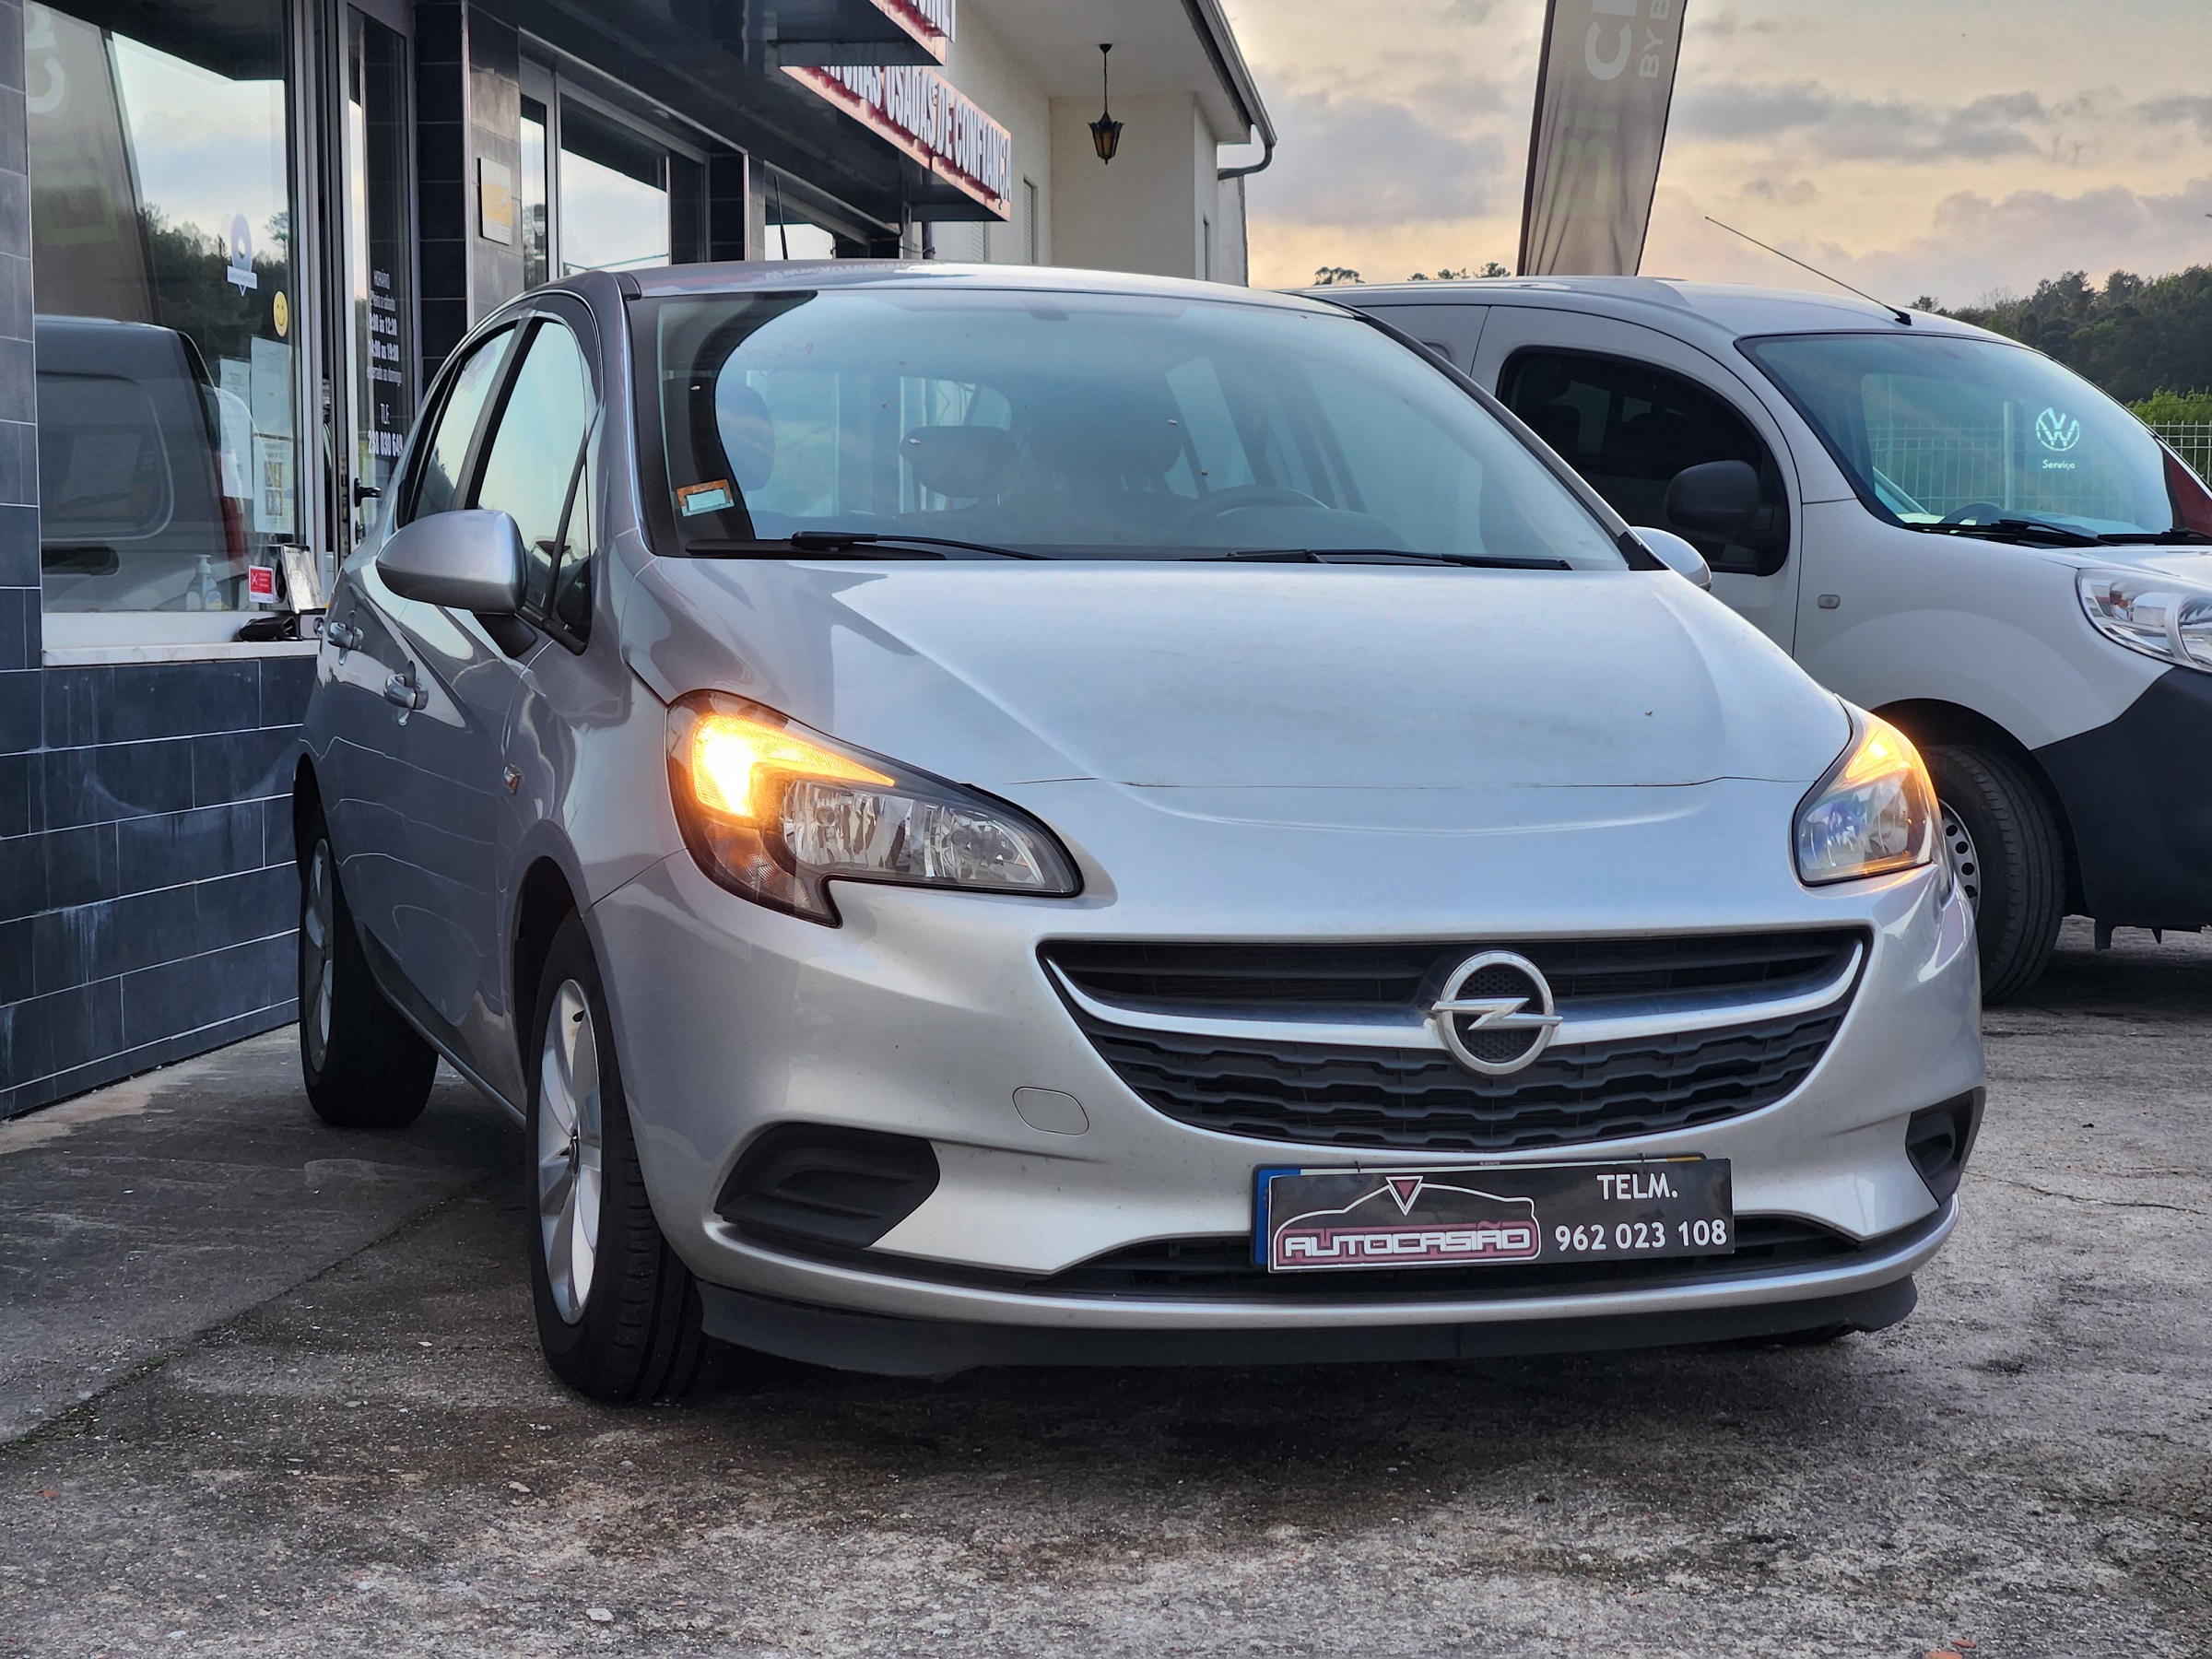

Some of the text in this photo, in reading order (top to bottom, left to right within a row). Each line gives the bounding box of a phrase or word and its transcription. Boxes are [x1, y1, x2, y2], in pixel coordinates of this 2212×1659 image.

[1638, 27, 1664, 79] BY
[886, 65, 935, 149] USADAS
[936, 82, 953, 160] DE
[954, 97, 1011, 210] CONFIANÇA
[1596, 1172, 1678, 1200] TELM.
[1285, 1220, 1532, 1257] AUTOCASIÃO
[1555, 1218, 1727, 1252] 962 023 108
